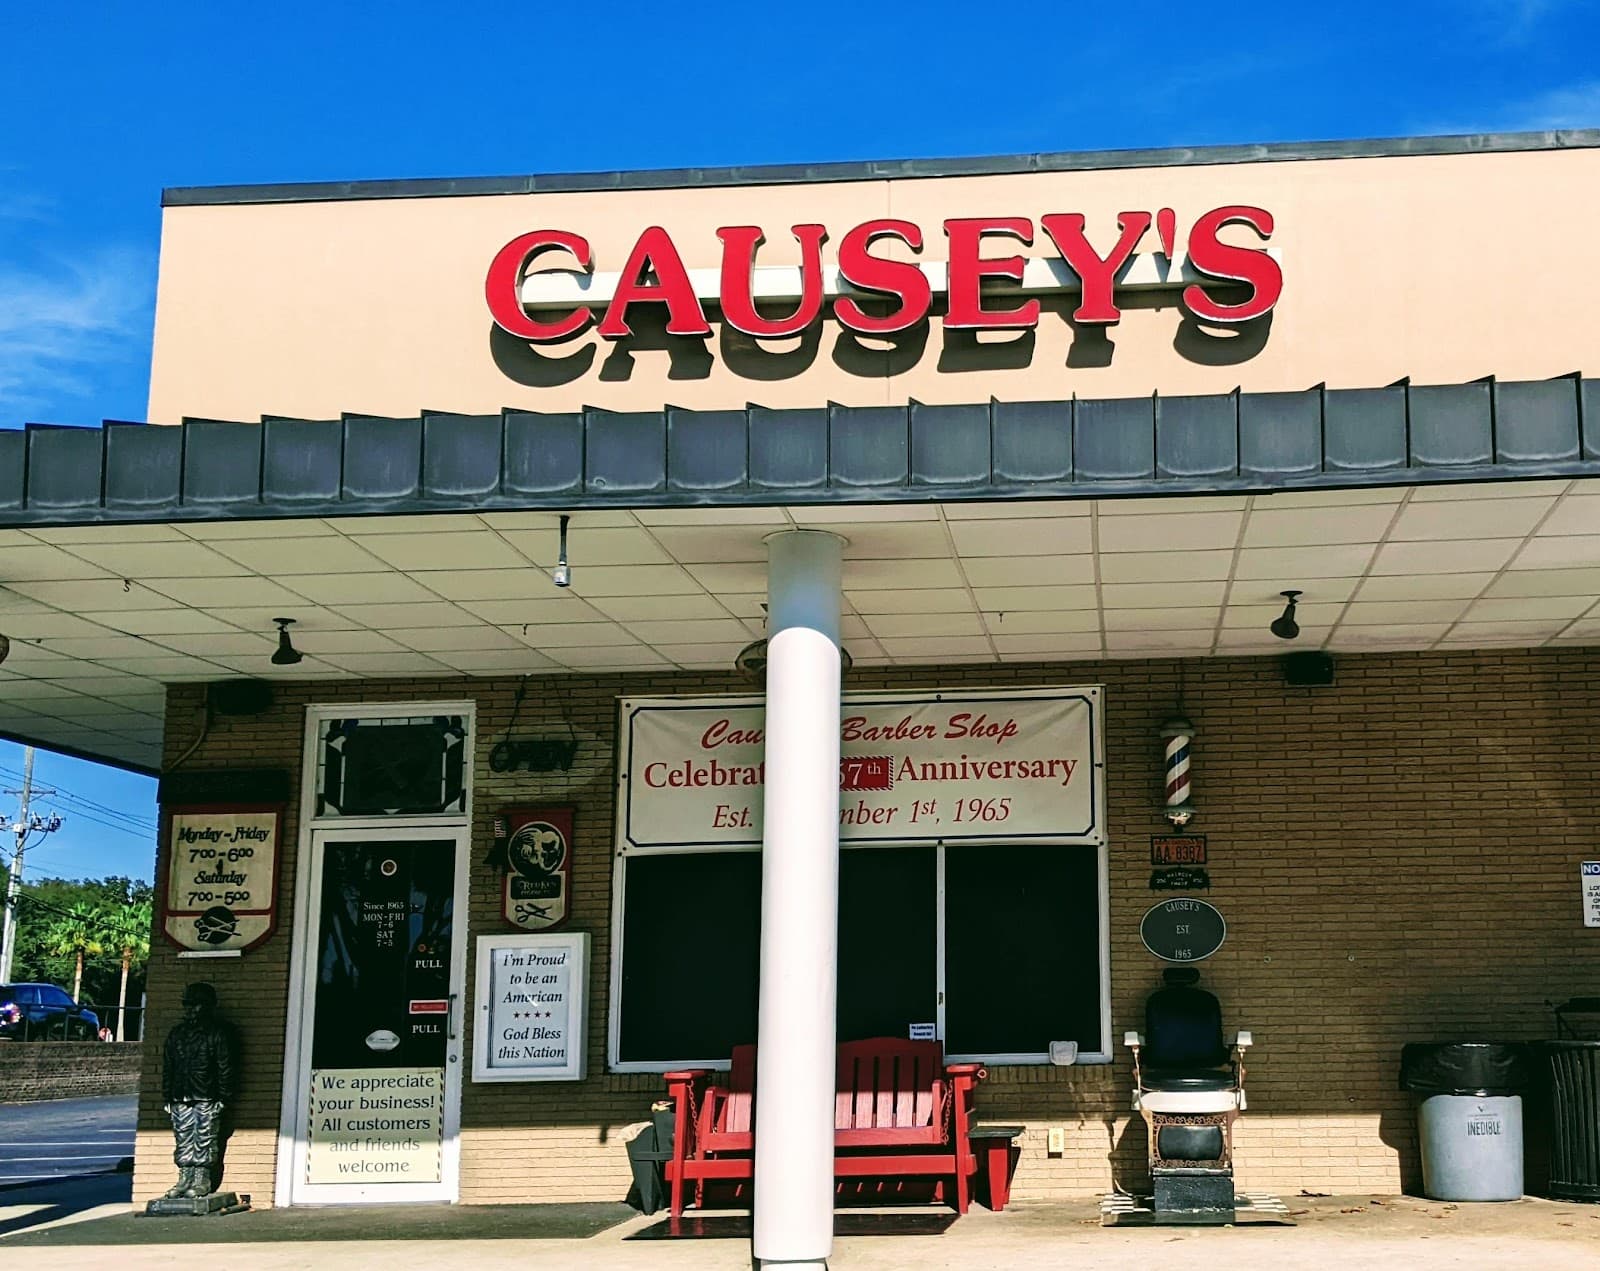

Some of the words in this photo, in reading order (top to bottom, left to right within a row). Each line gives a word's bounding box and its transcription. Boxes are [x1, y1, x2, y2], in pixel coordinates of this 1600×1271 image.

[485, 205, 1283, 341] CAUSEY'S
[701, 719, 766, 749] Cau
[840, 715, 937, 742] Barber
[944, 713, 1018, 744] Shop
[895, 754, 1078, 786] Anniversary
[712, 804, 753, 828] Est.
[952, 797, 1012, 823] 1965
[193, 869, 248, 886] Saturday
[363, 901, 385, 910] Since
[387, 900, 405, 910] 1965
[376, 930, 395, 939] SAT
[503, 953, 524, 967] I'm
[527, 952, 566, 966] Proud
[1174, 948, 1192, 959] 1965
[415, 959, 443, 969] PULL
[509, 974, 521, 985] to
[525, 972, 539, 985] be
[541, 975, 558, 985] an
[502, 990, 563, 1004] American
[412, 1025, 440, 1034] PULL
[503, 1027, 530, 1041] God
[532, 1027, 562, 1040] Bless
[498, 1047, 521, 1060] this
[523, 1046, 565, 1059] Nation
[321, 1076, 346, 1089] We
[350, 1074, 435, 1092] appreciate
[318, 1099, 355, 1114] your
[360, 1095, 435, 1109] business!
[321, 1118, 341, 1131] All
[347, 1117, 431, 1131] customers
[1467, 1121, 1501, 1136] INEDIBLE
[329, 1139, 359, 1152] and
[365, 1137, 421, 1152] friends
[338, 1159, 410, 1173] welcome
